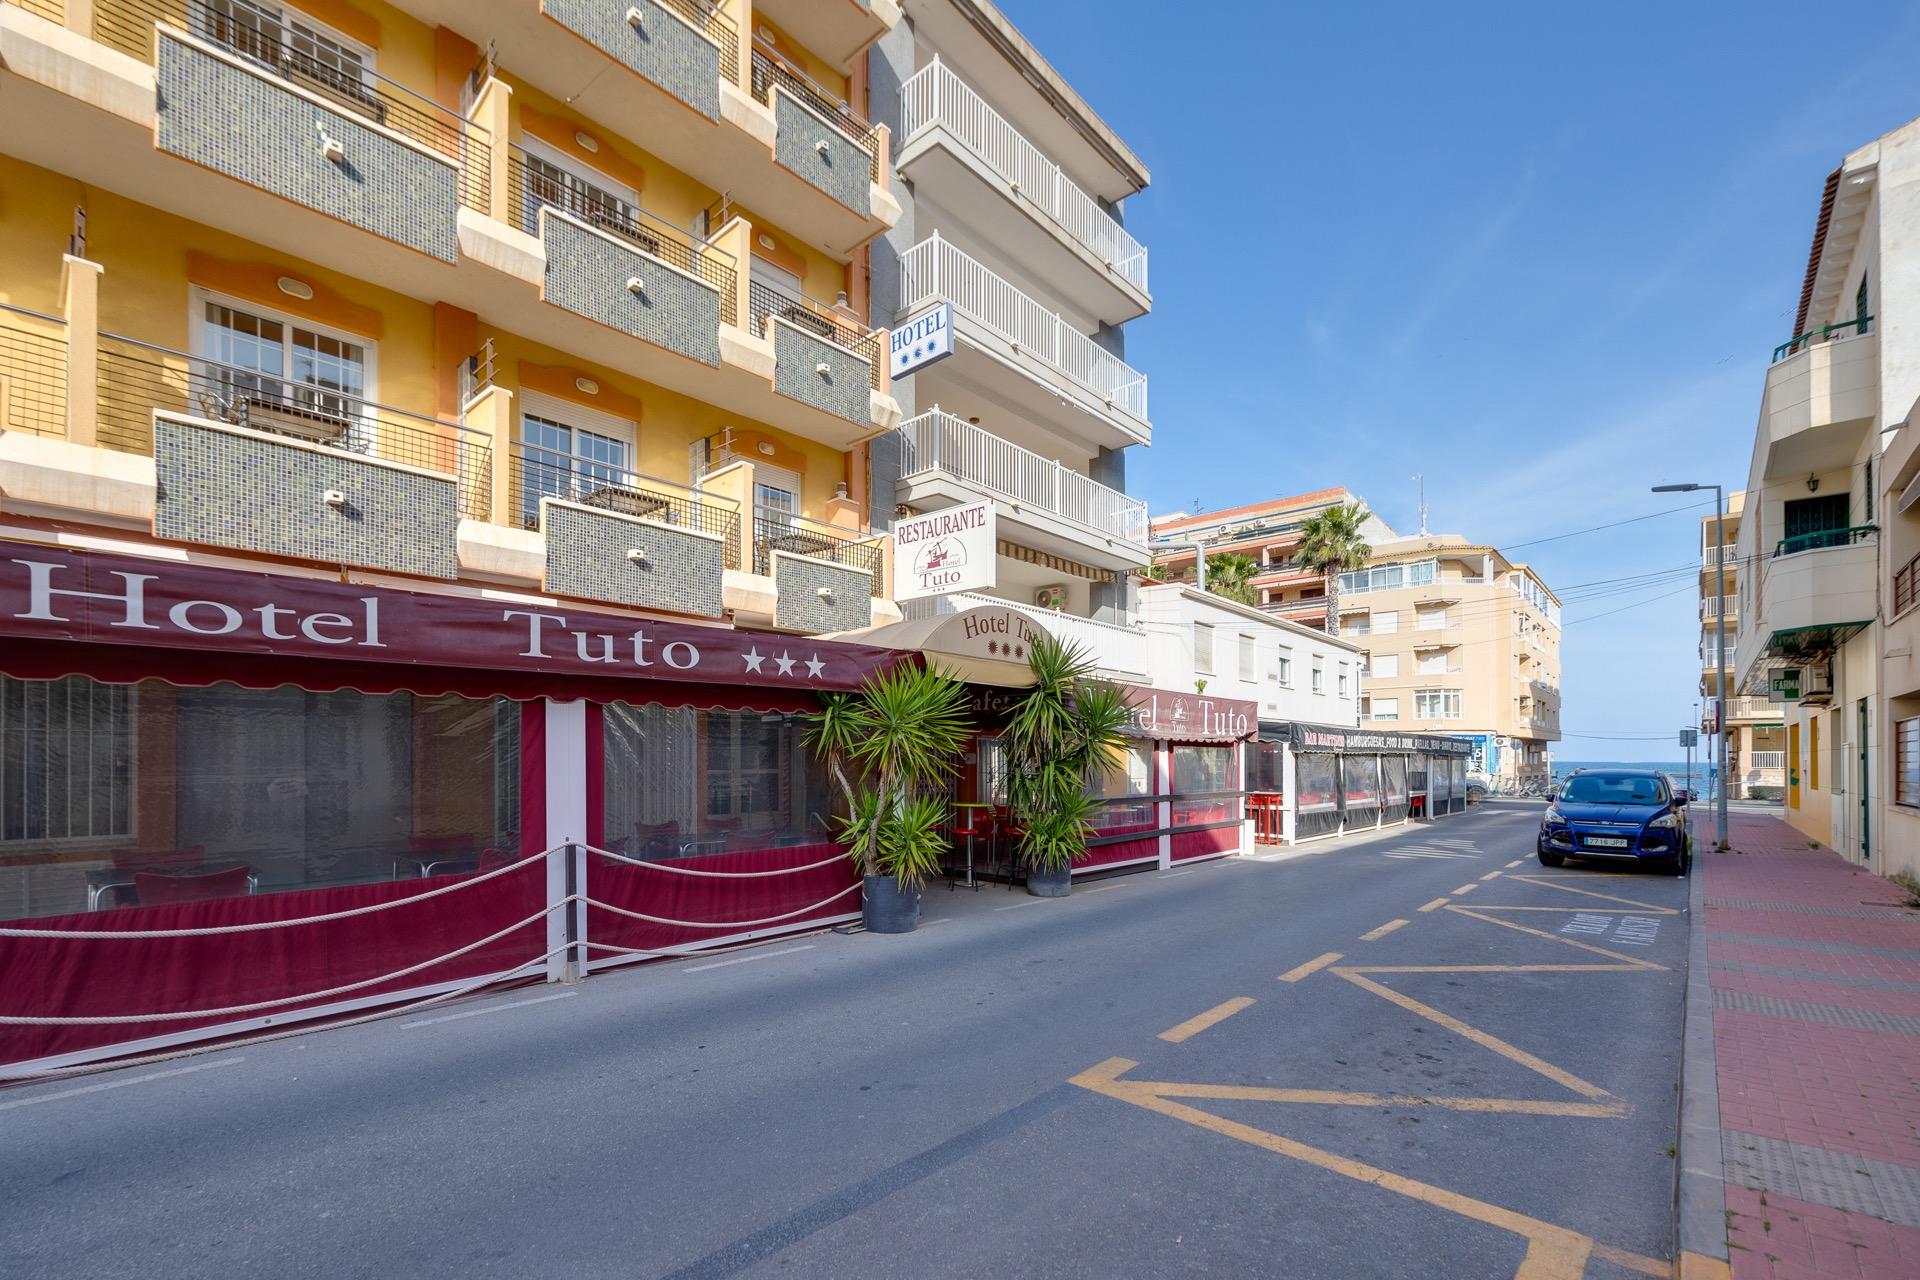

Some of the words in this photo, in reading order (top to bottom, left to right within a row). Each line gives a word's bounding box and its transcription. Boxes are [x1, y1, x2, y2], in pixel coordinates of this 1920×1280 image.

[891, 310, 946, 354] HOTEL
[898, 506, 986, 546] RESTAURANTE
[919, 571, 961, 588] Tuto
[11, 558, 387, 648] Hotel
[503, 610, 700, 670] Tuto
[962, 612, 1010, 640] Hotel
[1198, 700, 1248, 737] Tuto
